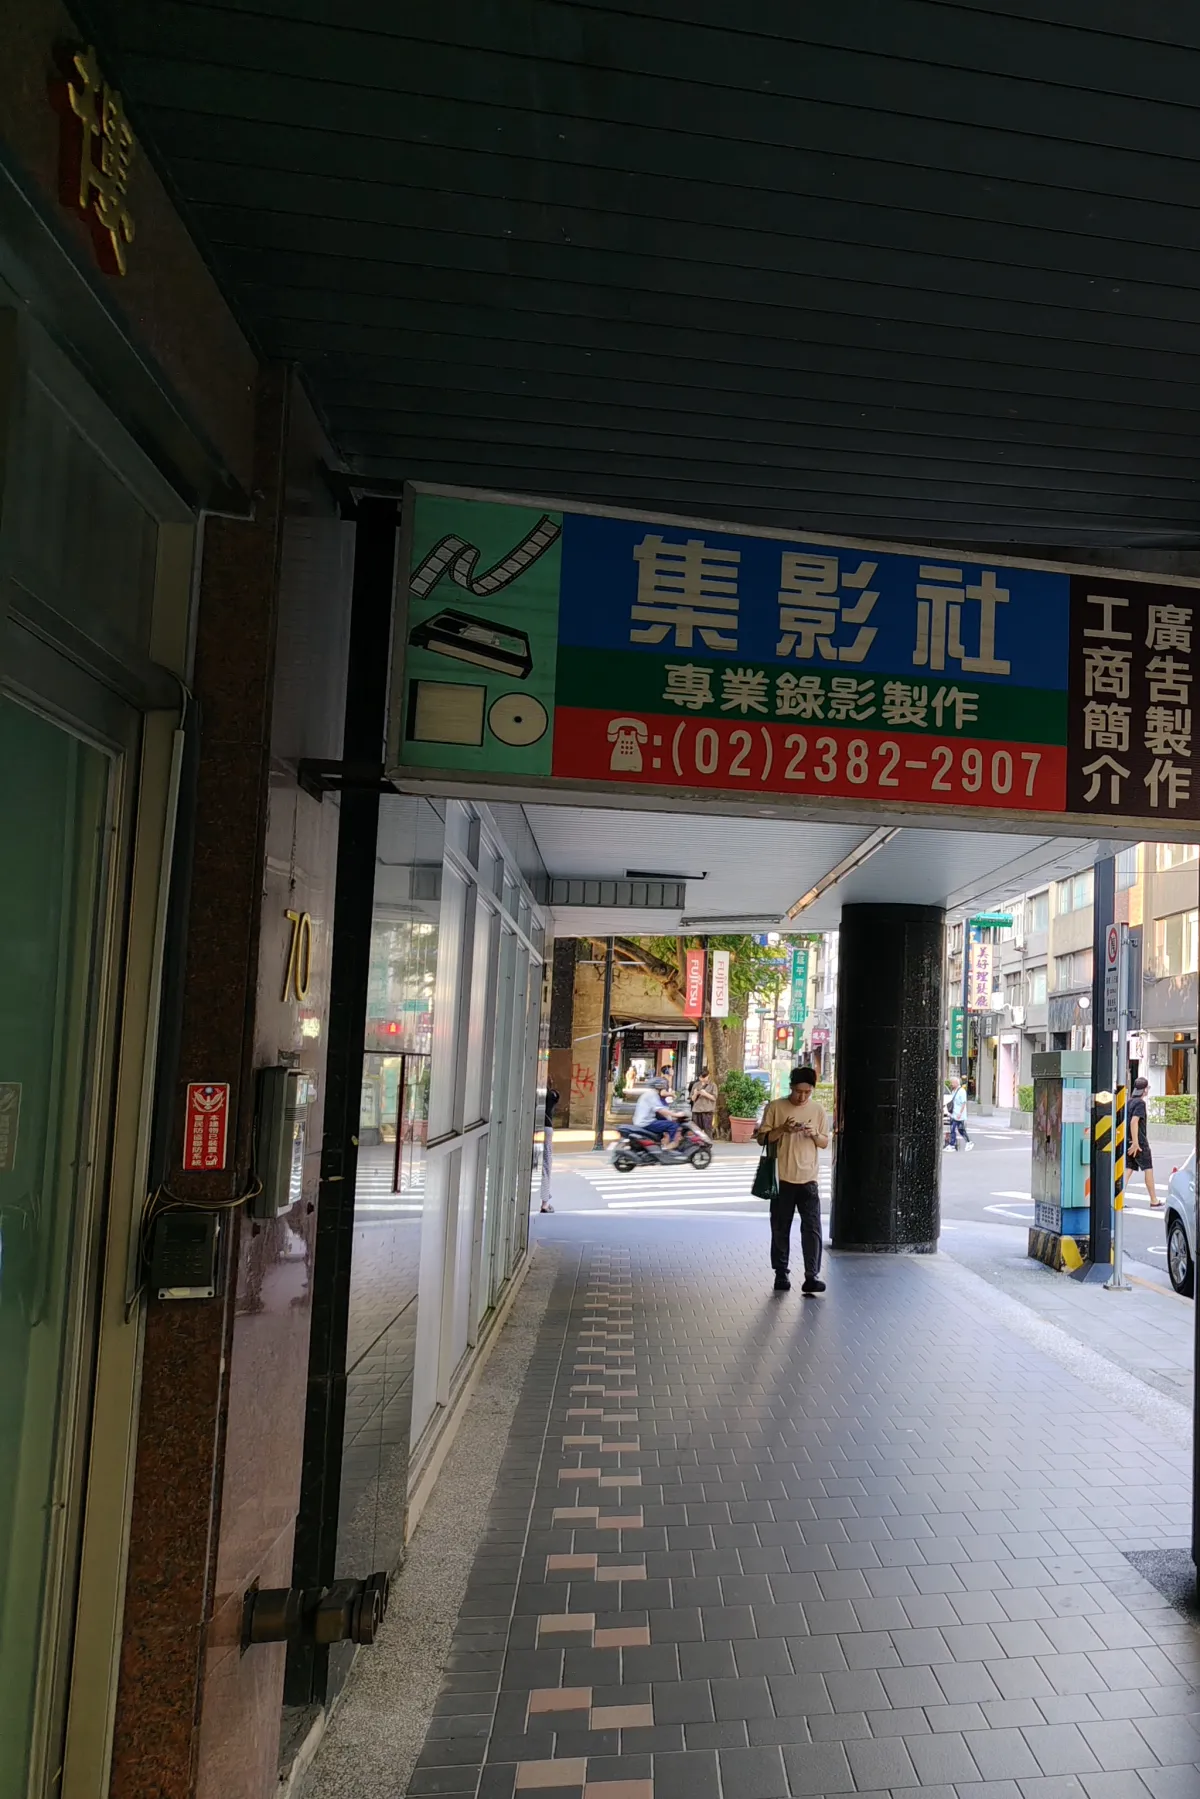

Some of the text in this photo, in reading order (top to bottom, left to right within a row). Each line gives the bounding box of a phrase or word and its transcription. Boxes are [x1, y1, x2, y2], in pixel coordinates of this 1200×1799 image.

[629, 533, 1011, 675] 集影社
[662, 663, 980, 730] 專業錄影製作
[1082, 595, 1133, 805] 工商簡介
[1143, 604, 1194, 809] 廣告製作
[283, 908, 312, 1002] 70
[689, 959, 703, 1007] FUJITSU
[716, 960, 727, 1007] FUJITSU
